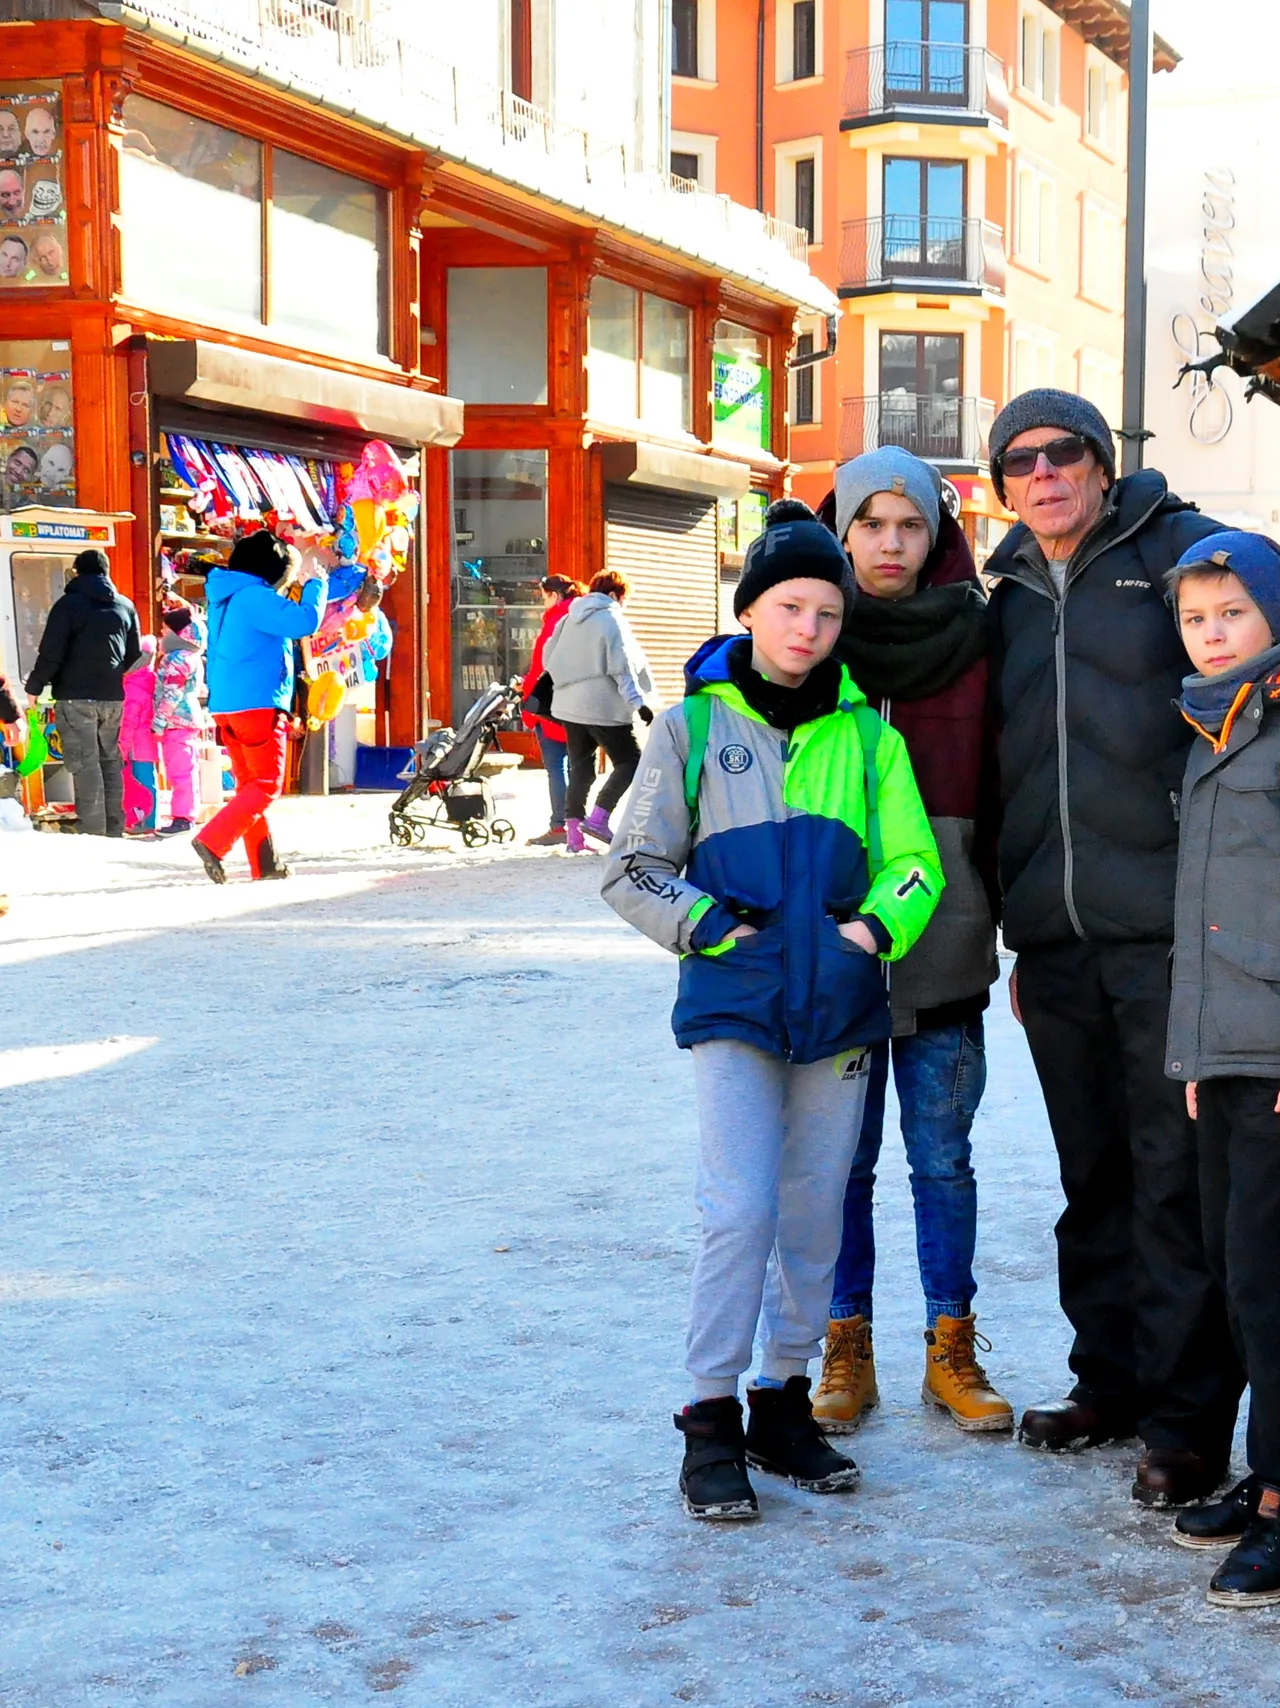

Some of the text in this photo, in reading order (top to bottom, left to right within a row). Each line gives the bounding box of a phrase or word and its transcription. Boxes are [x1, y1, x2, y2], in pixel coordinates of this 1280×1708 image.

[37, 524, 87, 539] WPŁATOMAT
[1123, 580, 1151, 588] HI-TEC
[729, 754, 744, 763] SKI
[626, 767, 662, 850] SKIING
